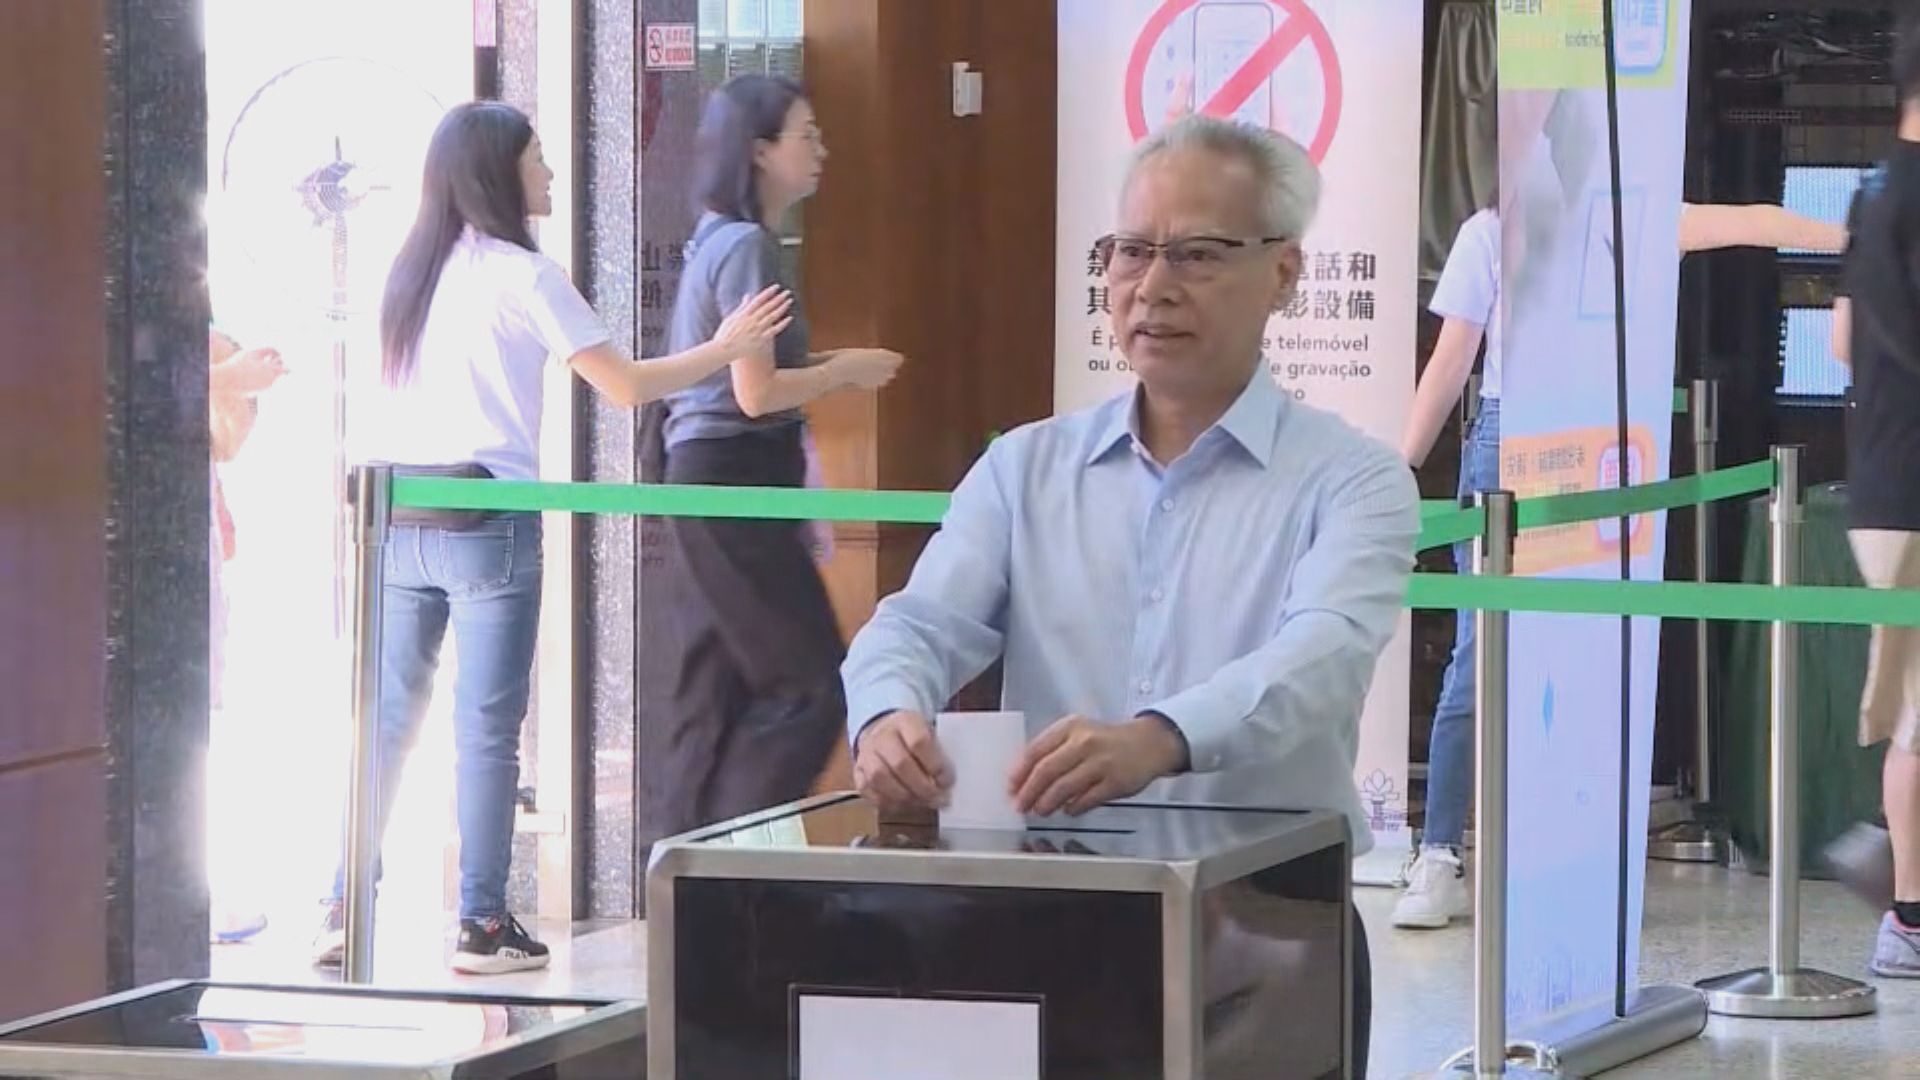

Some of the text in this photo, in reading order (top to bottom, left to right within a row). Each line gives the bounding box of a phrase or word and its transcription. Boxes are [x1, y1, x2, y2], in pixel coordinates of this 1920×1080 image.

[1297, 251, 1376, 281] 話和
[1091, 325, 1103, 345] É
[1278, 332, 1368, 351] telemóvel
[1088, 359, 1110, 371] ou
[1287, 359, 1371, 380] gravação
